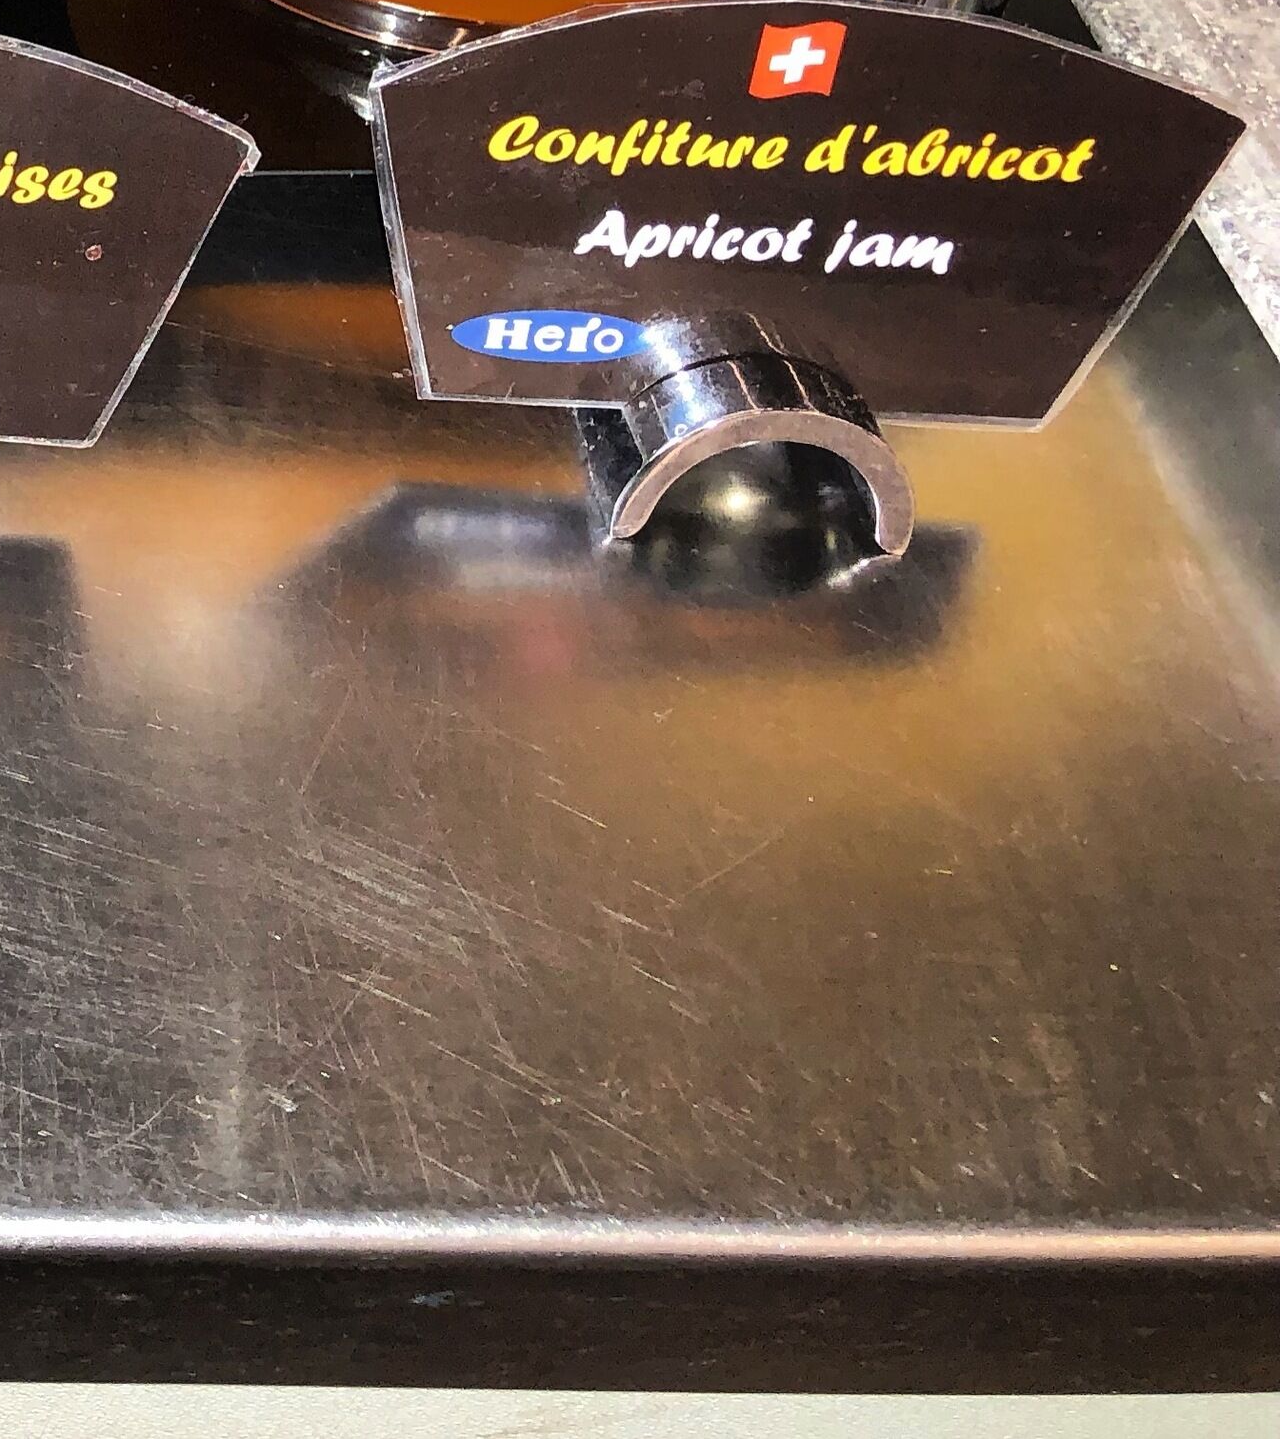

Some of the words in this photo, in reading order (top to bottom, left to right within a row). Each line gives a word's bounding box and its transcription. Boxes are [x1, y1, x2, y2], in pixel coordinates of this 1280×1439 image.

[487, 115, 789, 176] Confiture
[804, 124, 1096, 183] d'abricot
[573, 209, 814, 268] Apricot
[824, 219, 954, 275] jam
[483, 316, 624, 354] Hero
